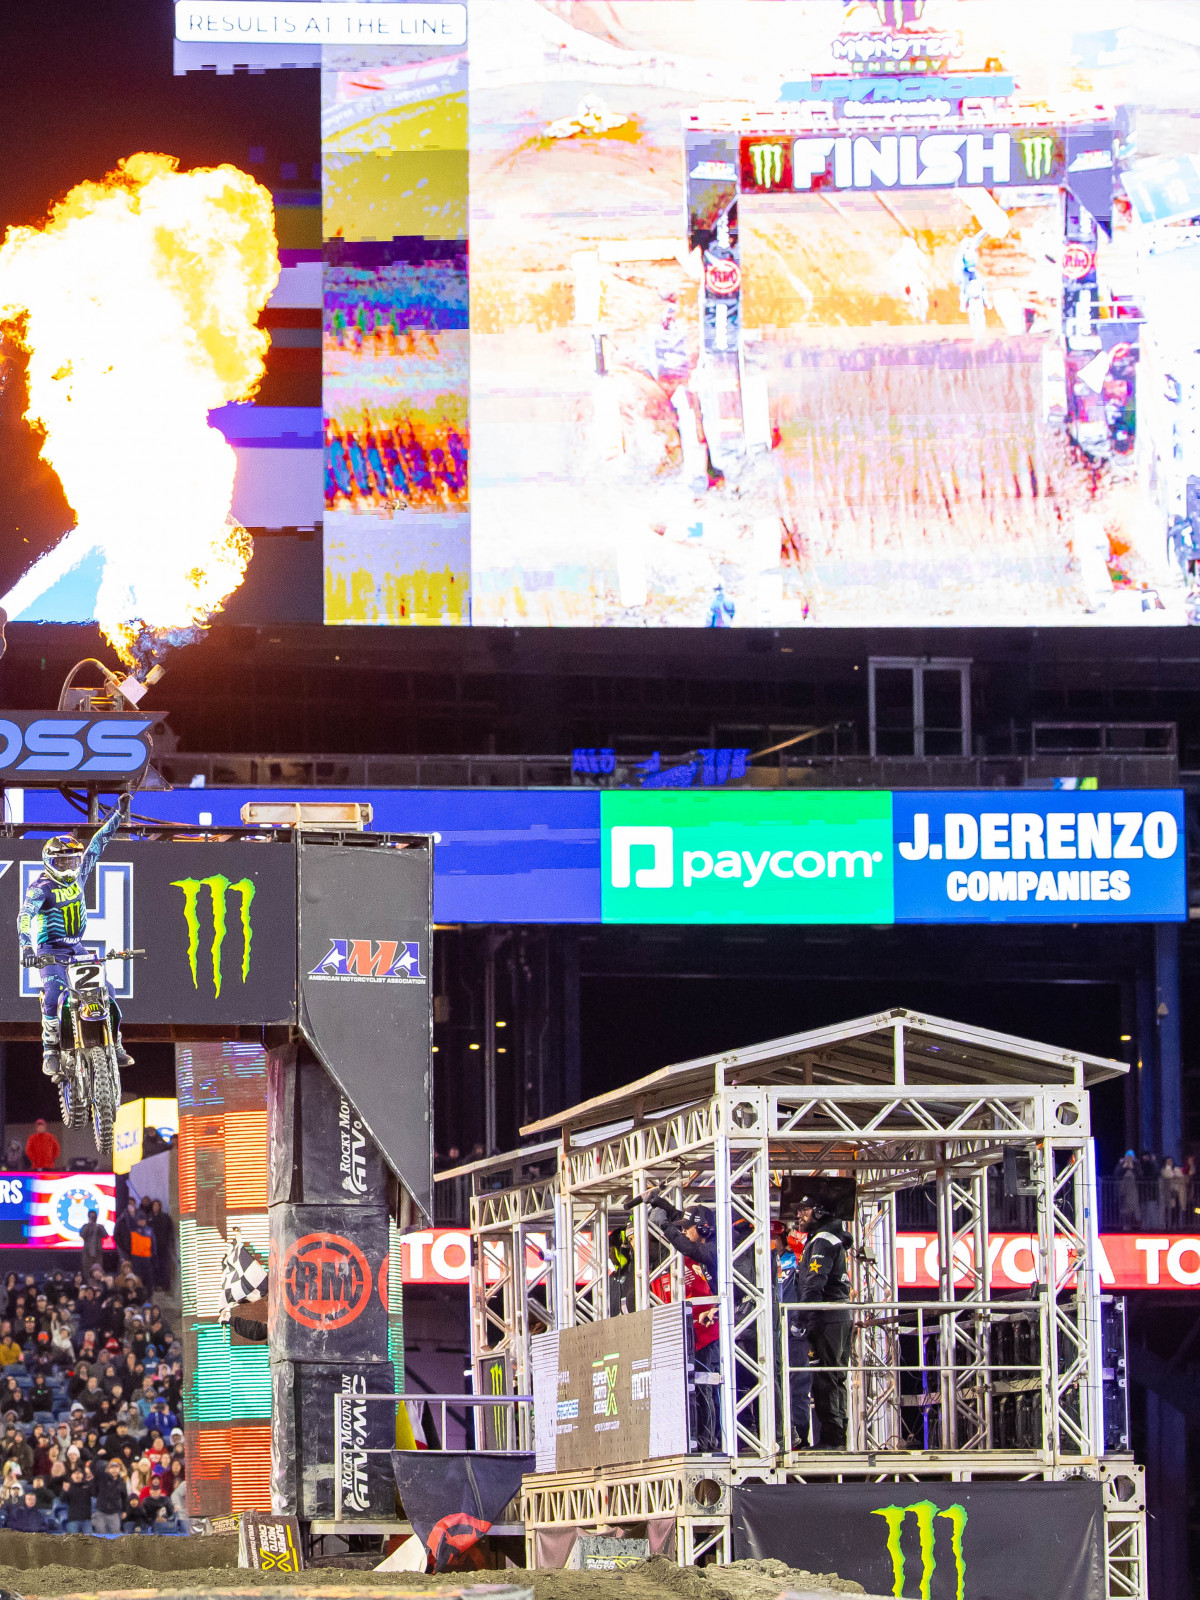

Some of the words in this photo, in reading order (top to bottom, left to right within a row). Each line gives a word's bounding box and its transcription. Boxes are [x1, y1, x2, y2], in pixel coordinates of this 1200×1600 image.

[189, 15, 296, 33] RESULTS
[305, 16, 332, 34] AT
[347, 17, 390, 34] THE
[400, 18, 453, 35] LINE
[792, 132, 1011, 189] FINISH
[899, 811, 1179, 862] J.DERENZO
[682, 847, 883, 888] paycom
[946, 869, 1131, 902] COMPANIES
[75, 966, 100, 991] 2
[307, 938, 427, 979] AMA
[387, 977, 426, 985] ASSOCIATION
[339, 1132, 351, 1174] ROCKY
[295, 1261, 350, 1302] RM
[341, 1447, 353, 1491] ROCKY
